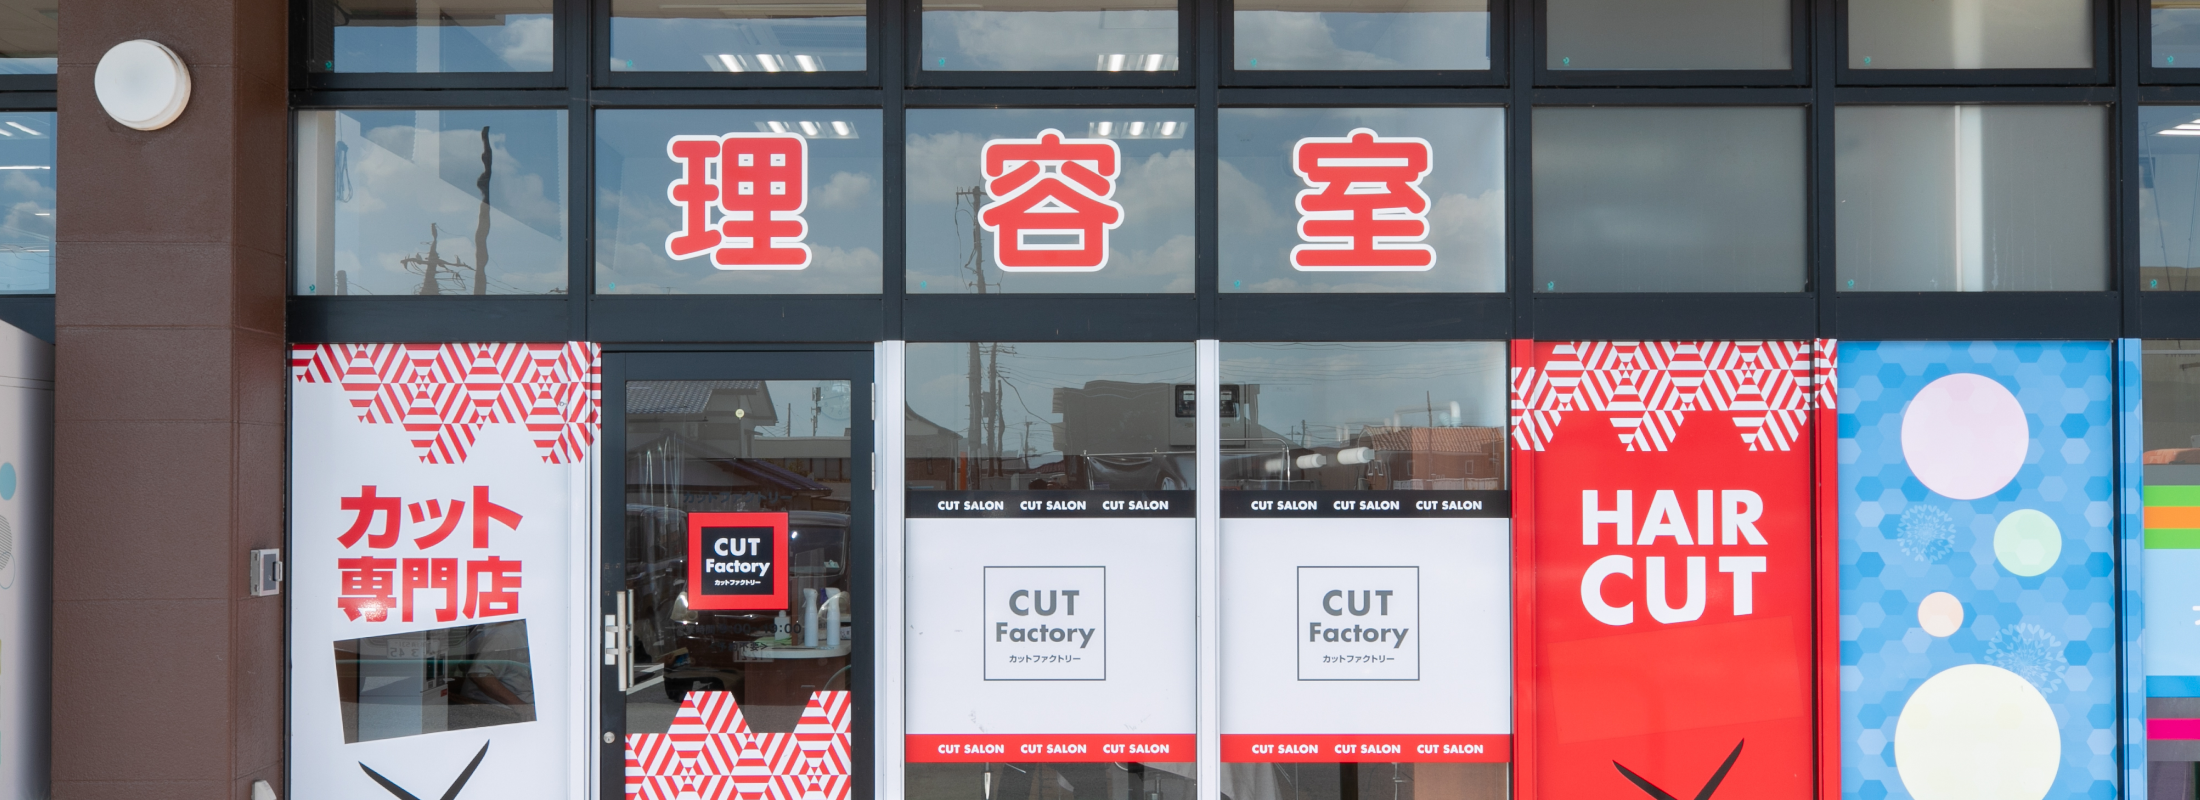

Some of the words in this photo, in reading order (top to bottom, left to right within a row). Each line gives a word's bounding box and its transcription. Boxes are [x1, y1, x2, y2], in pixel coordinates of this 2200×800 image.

[665, 128, 1437, 273] 理容室
[682, 491, 793, 504] カットファクトリー
[937, 500, 961, 511] CUT
[963, 500, 1004, 511] SALON
[1019, 500, 1043, 511] CUT
[1046, 500, 1087, 511] SALON
[1102, 500, 1125, 511] CUT
[1128, 500, 1169, 511] SALON
[1250, 500, 1274, 511] CUT
[1276, 500, 1318, 511] SALON
[1333, 500, 1356, 511] CUT
[1359, 500, 1400, 511] SALON
[1415, 500, 1439, 511] CUT
[1441, 500, 1483, 511] SALON
[337, 485, 523, 551] カット
[1581, 489, 1769, 546] HAIR
[714, 537, 761, 557] CUT
[705, 558, 771, 577] Factory
[337, 555, 522, 623] 専門店
[1580, 554, 1767, 626] CUT
[1008, 589, 1080, 617] CUT
[1321, 589, 1393, 617] CUT
[996, 622, 1096, 649] Factory
[1309, 622, 1409, 649] Factory
[1008, 654, 1081, 664] カットファクトリー
[1321, 654, 1394, 664] カットファクトリー
[937, 743, 961, 755] CUT
[963, 743, 1005, 755] SALON
[1020, 743, 1044, 755] CUT
[1046, 743, 1087, 755] SALON
[1102, 743, 1126, 755] CUT
[1128, 743, 1170, 755] SALON
[1251, 743, 1275, 755] CUT
[1277, 743, 1319, 755] SALON
[1334, 743, 1358, 755] CUT
[1360, 743, 1401, 755] SALON
[1416, 743, 1440, 755] CUT
[1442, 743, 1484, 755] SALON
